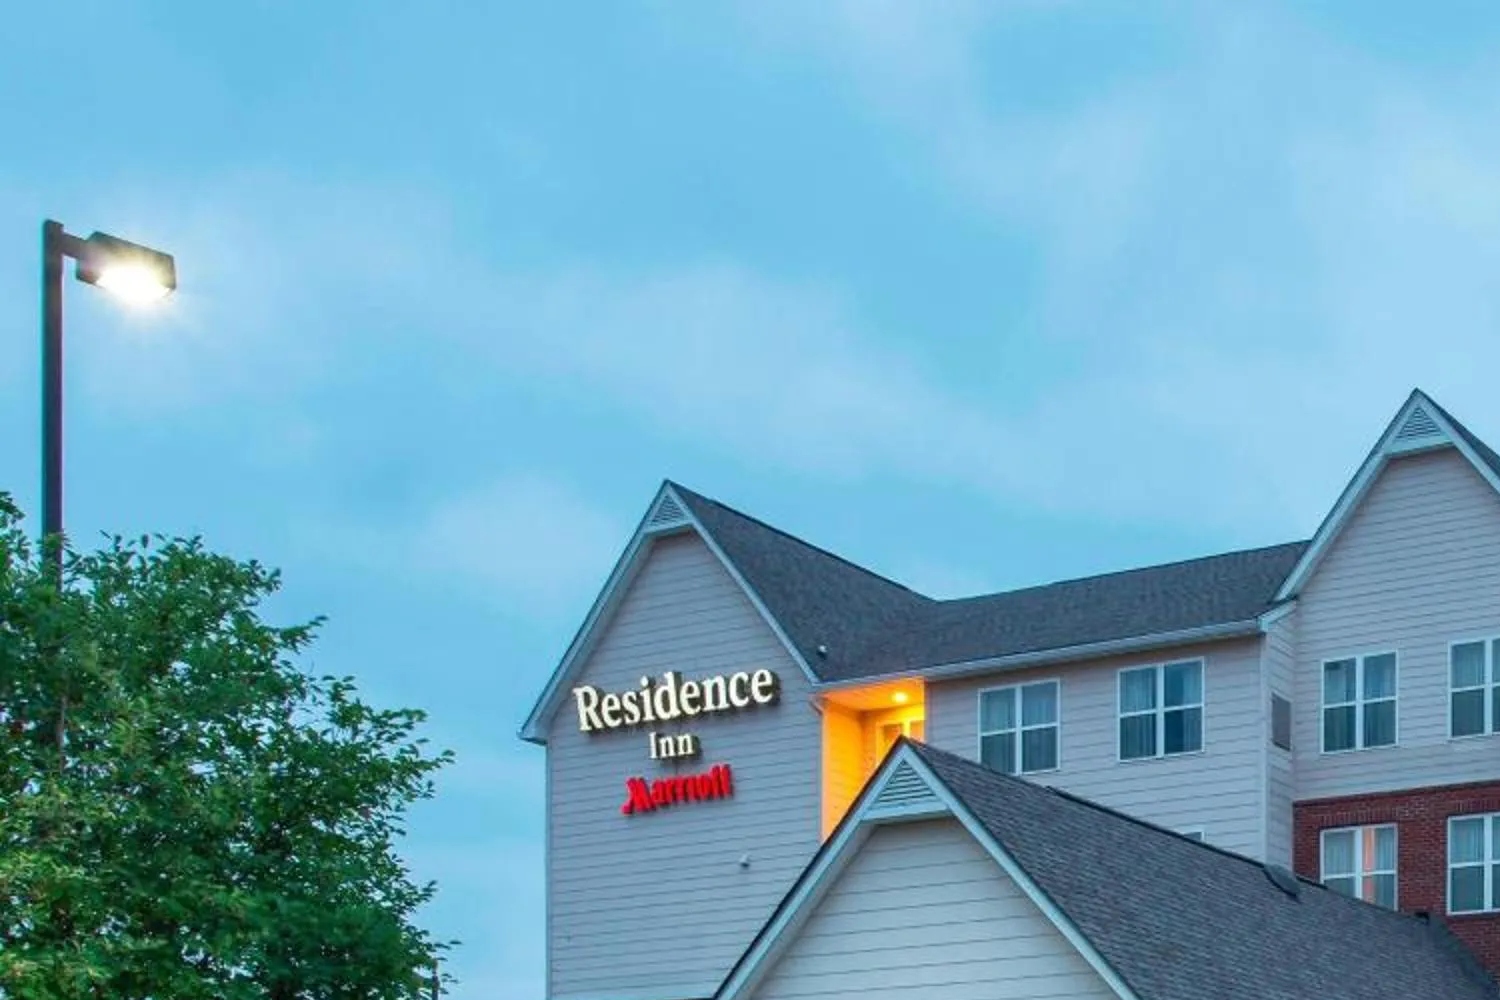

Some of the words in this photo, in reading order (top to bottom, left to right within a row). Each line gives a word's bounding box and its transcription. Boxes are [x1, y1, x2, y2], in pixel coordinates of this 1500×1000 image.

[573, 669, 775, 731] Residence
[650, 731, 694, 759] Inn
[620, 763, 732, 815] Marriott
